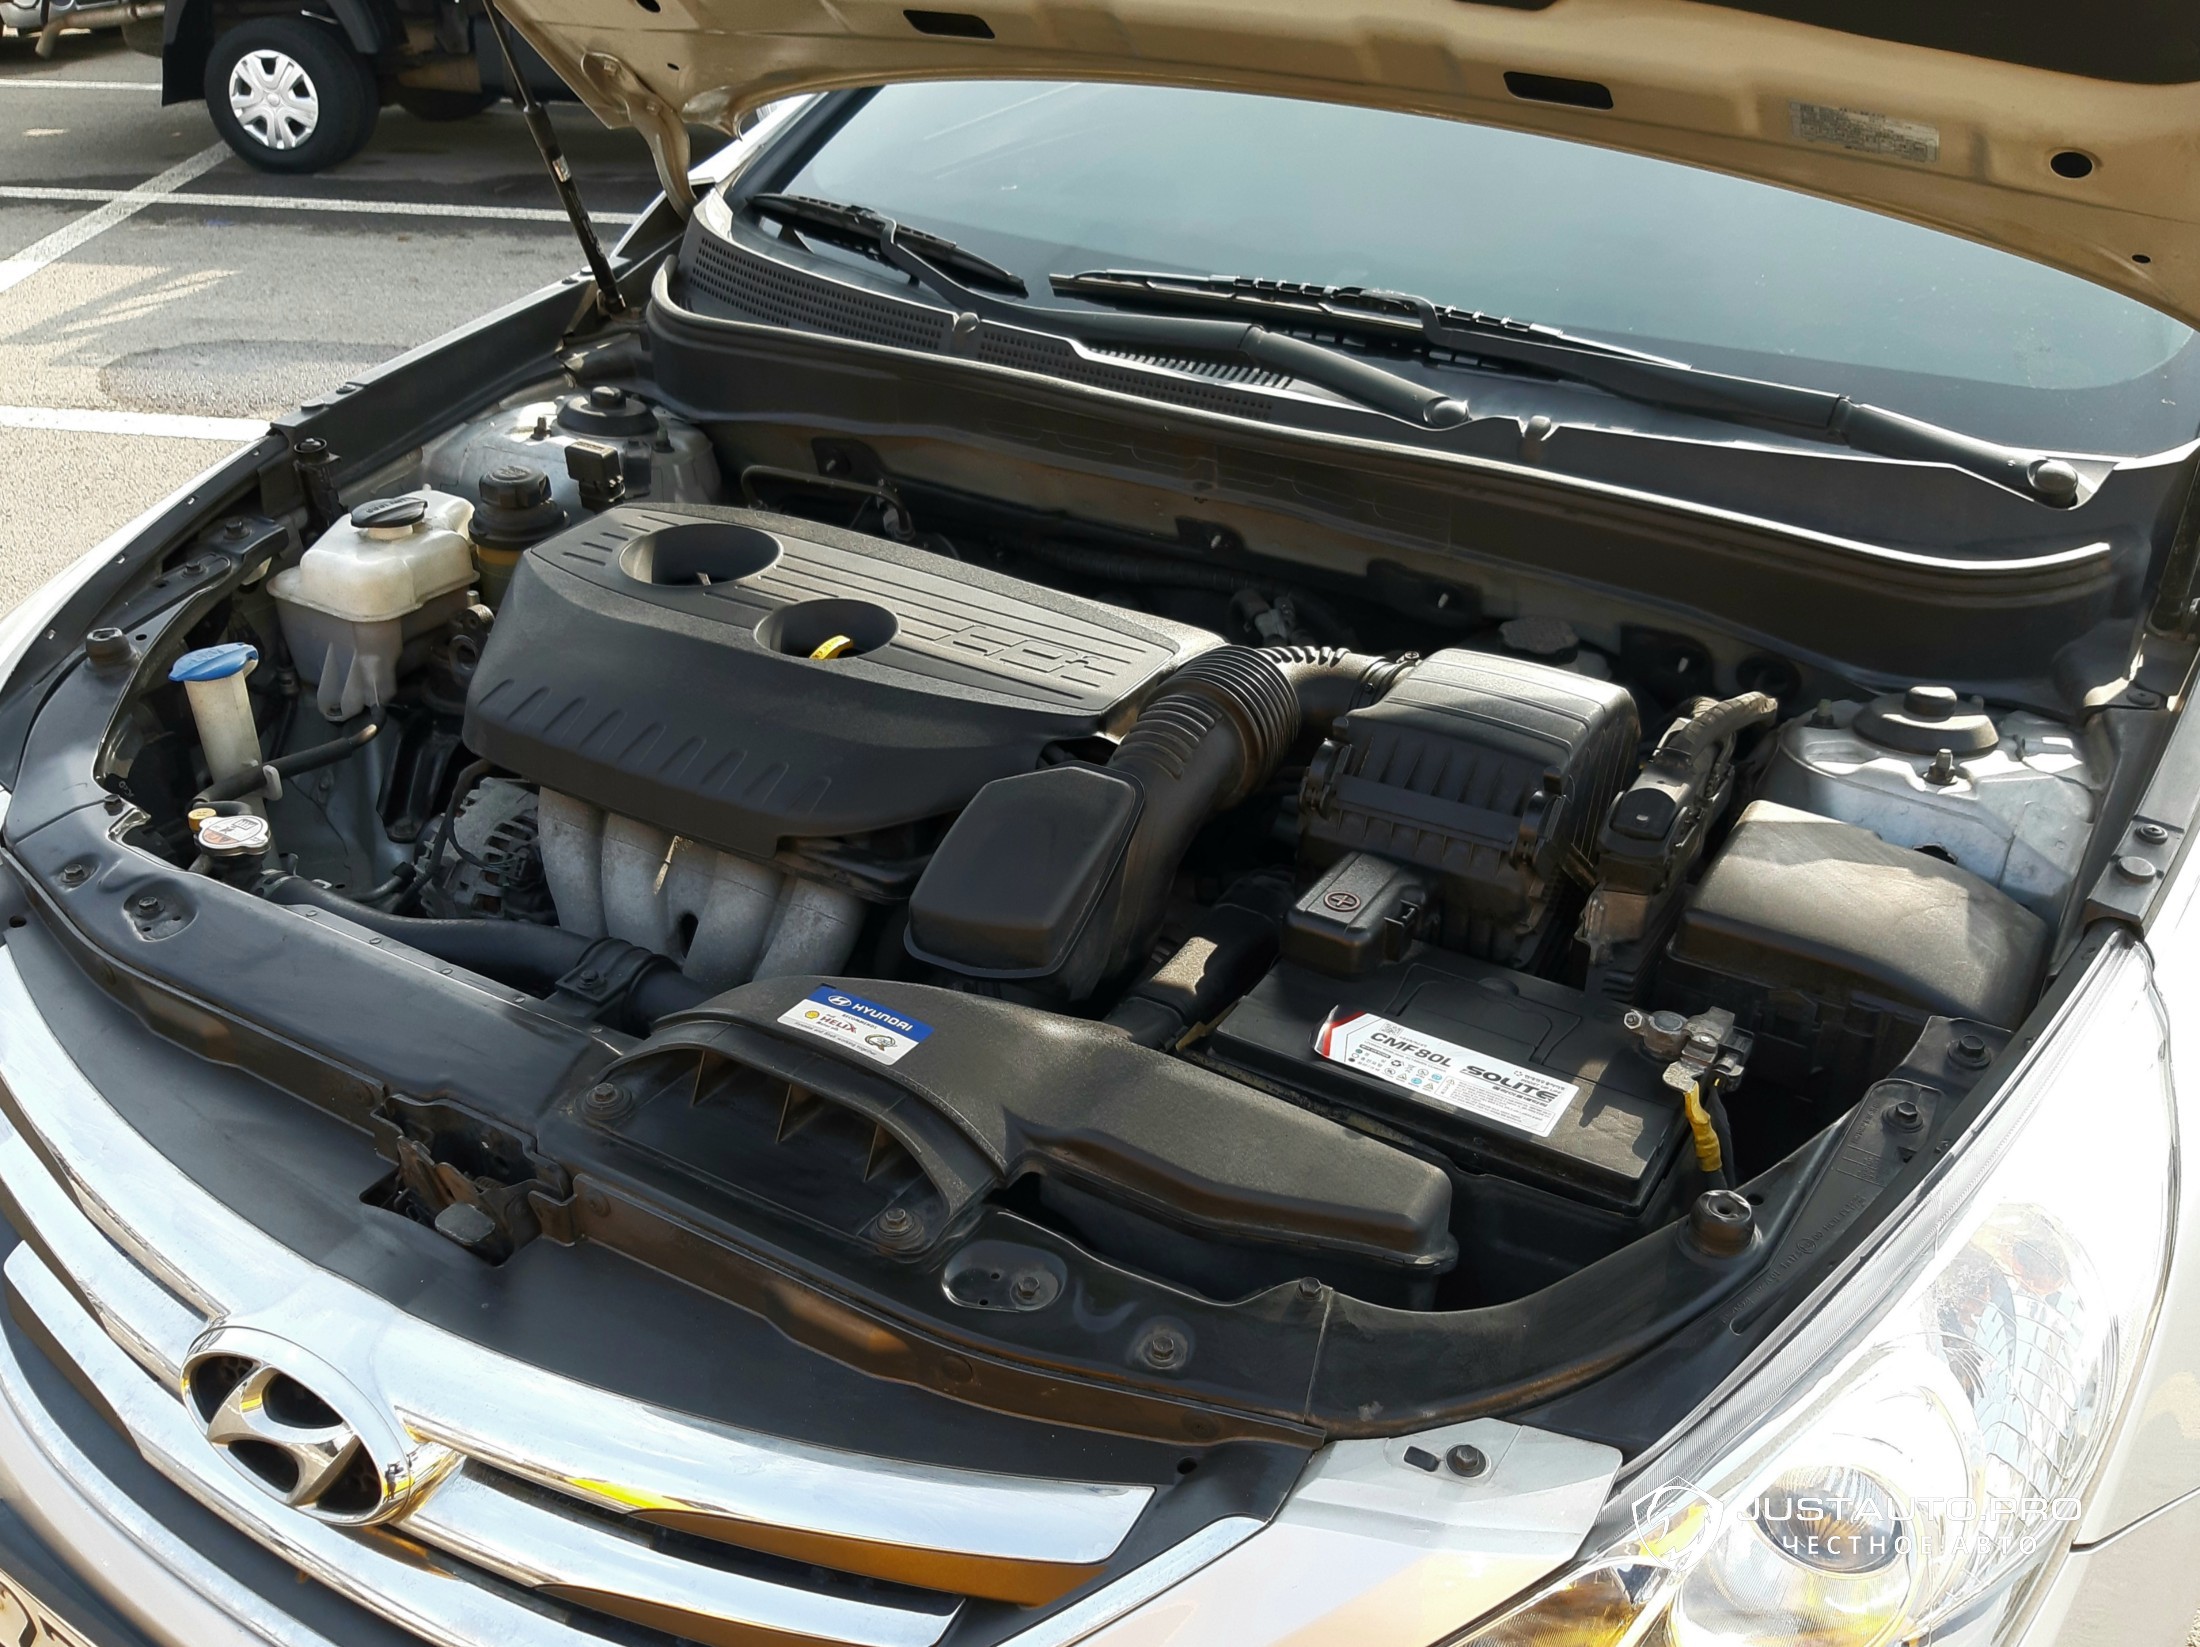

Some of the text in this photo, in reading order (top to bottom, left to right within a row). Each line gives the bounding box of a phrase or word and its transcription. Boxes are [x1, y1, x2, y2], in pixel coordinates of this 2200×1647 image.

[820, 1016, 857, 1034] HELIX
[852, 1003, 914, 1032] HYUNDAI
[1370, 1032, 1452, 1067] CMF80L
[1462, 1065, 1559, 1101] SOLITE
